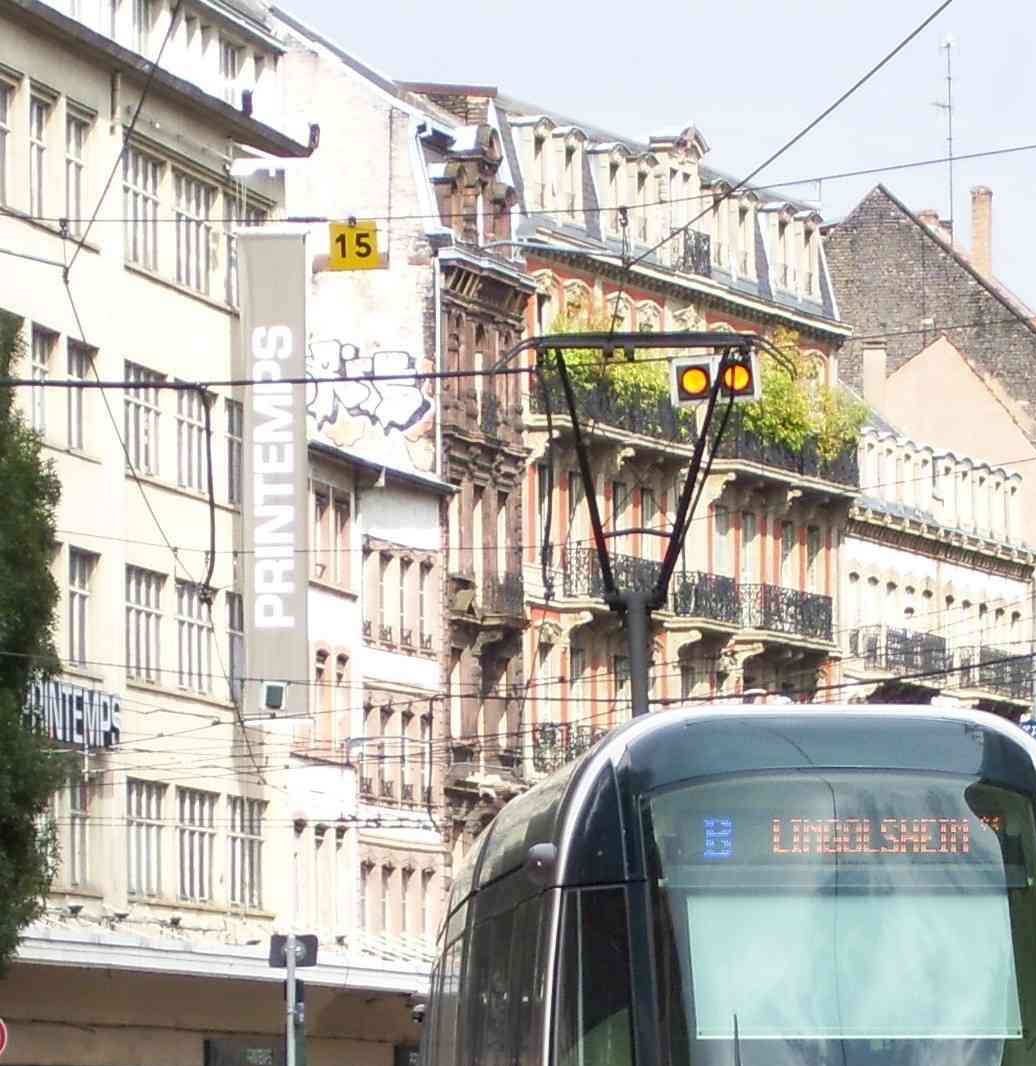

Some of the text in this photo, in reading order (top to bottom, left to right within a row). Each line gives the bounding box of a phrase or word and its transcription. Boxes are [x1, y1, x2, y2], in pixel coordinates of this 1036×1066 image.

[335, 232, 372, 259] 15
[251, 324, 296, 630] PRINTEMPS
[770, 818, 970, 854] LINGOLSHEIM
